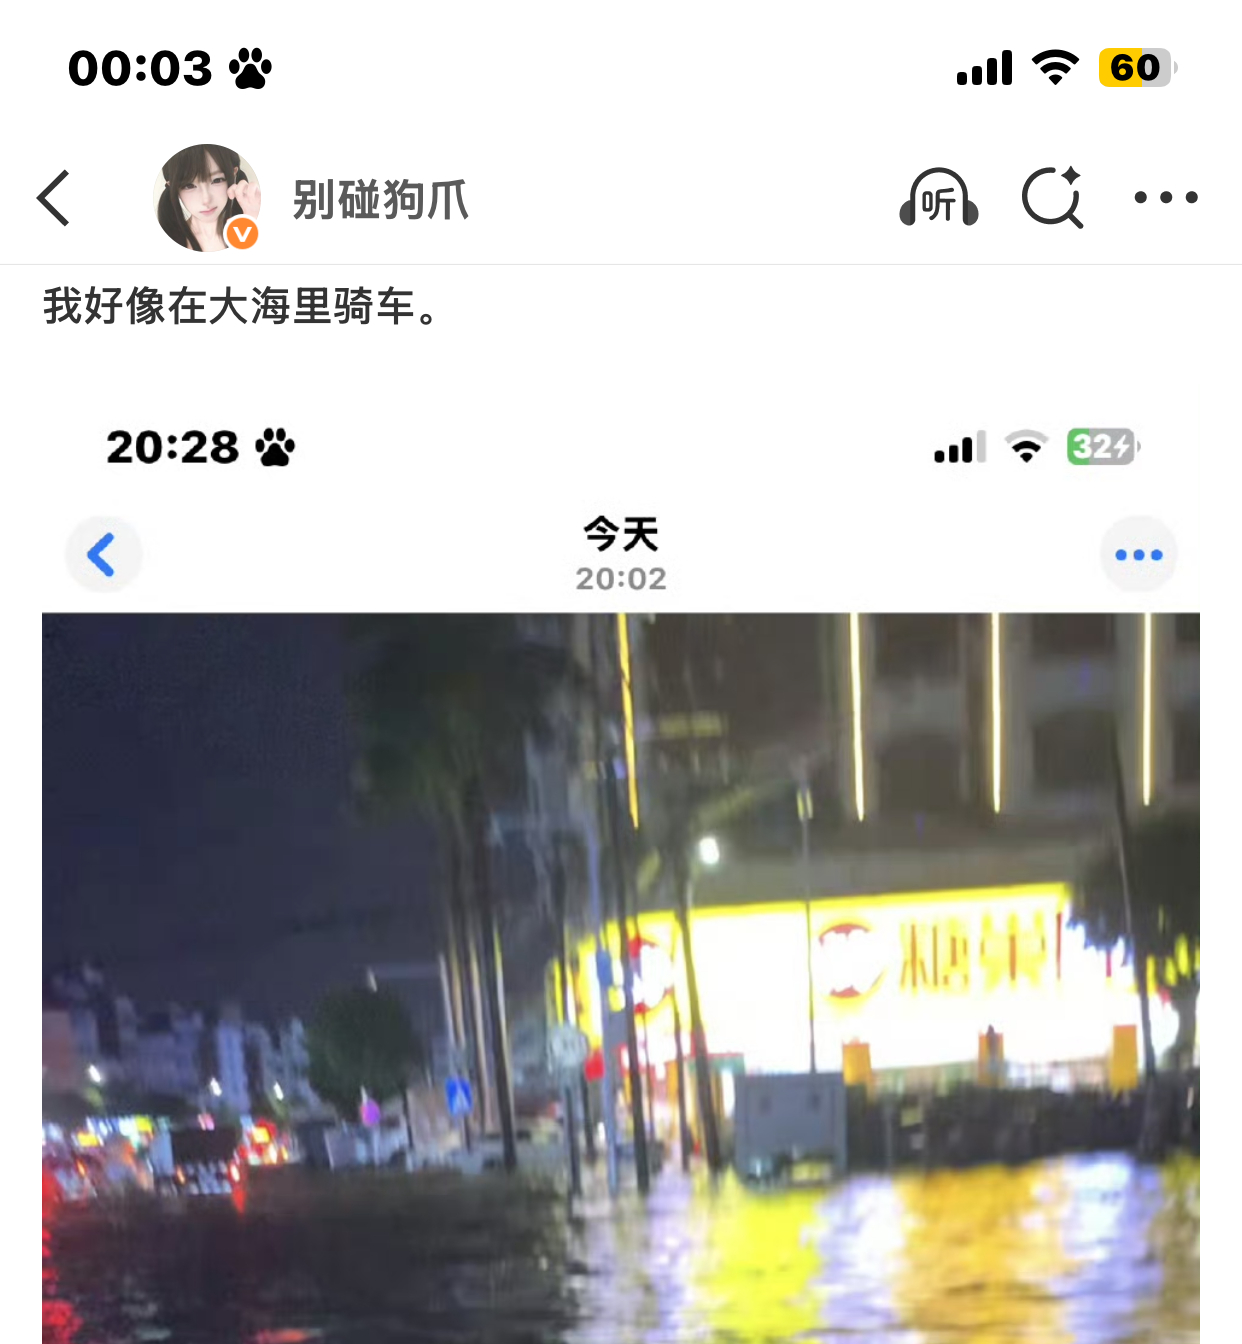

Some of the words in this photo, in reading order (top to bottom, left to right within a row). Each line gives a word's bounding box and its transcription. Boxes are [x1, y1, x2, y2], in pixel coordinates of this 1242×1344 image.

[69, 49, 213, 87] 00:03
[1110, 53, 1160, 82] 60
[293, 178, 469, 221] 别碰狗爪
[922, 187, 956, 222] 听
[43, 285, 434, 326] 我好像在大海里骑车。
[106, 429, 240, 465] 20:28
[1072, 433, 1112, 459] 32
[582, 514, 659, 553] 今天
[576, 567, 667, 591] 20:02
